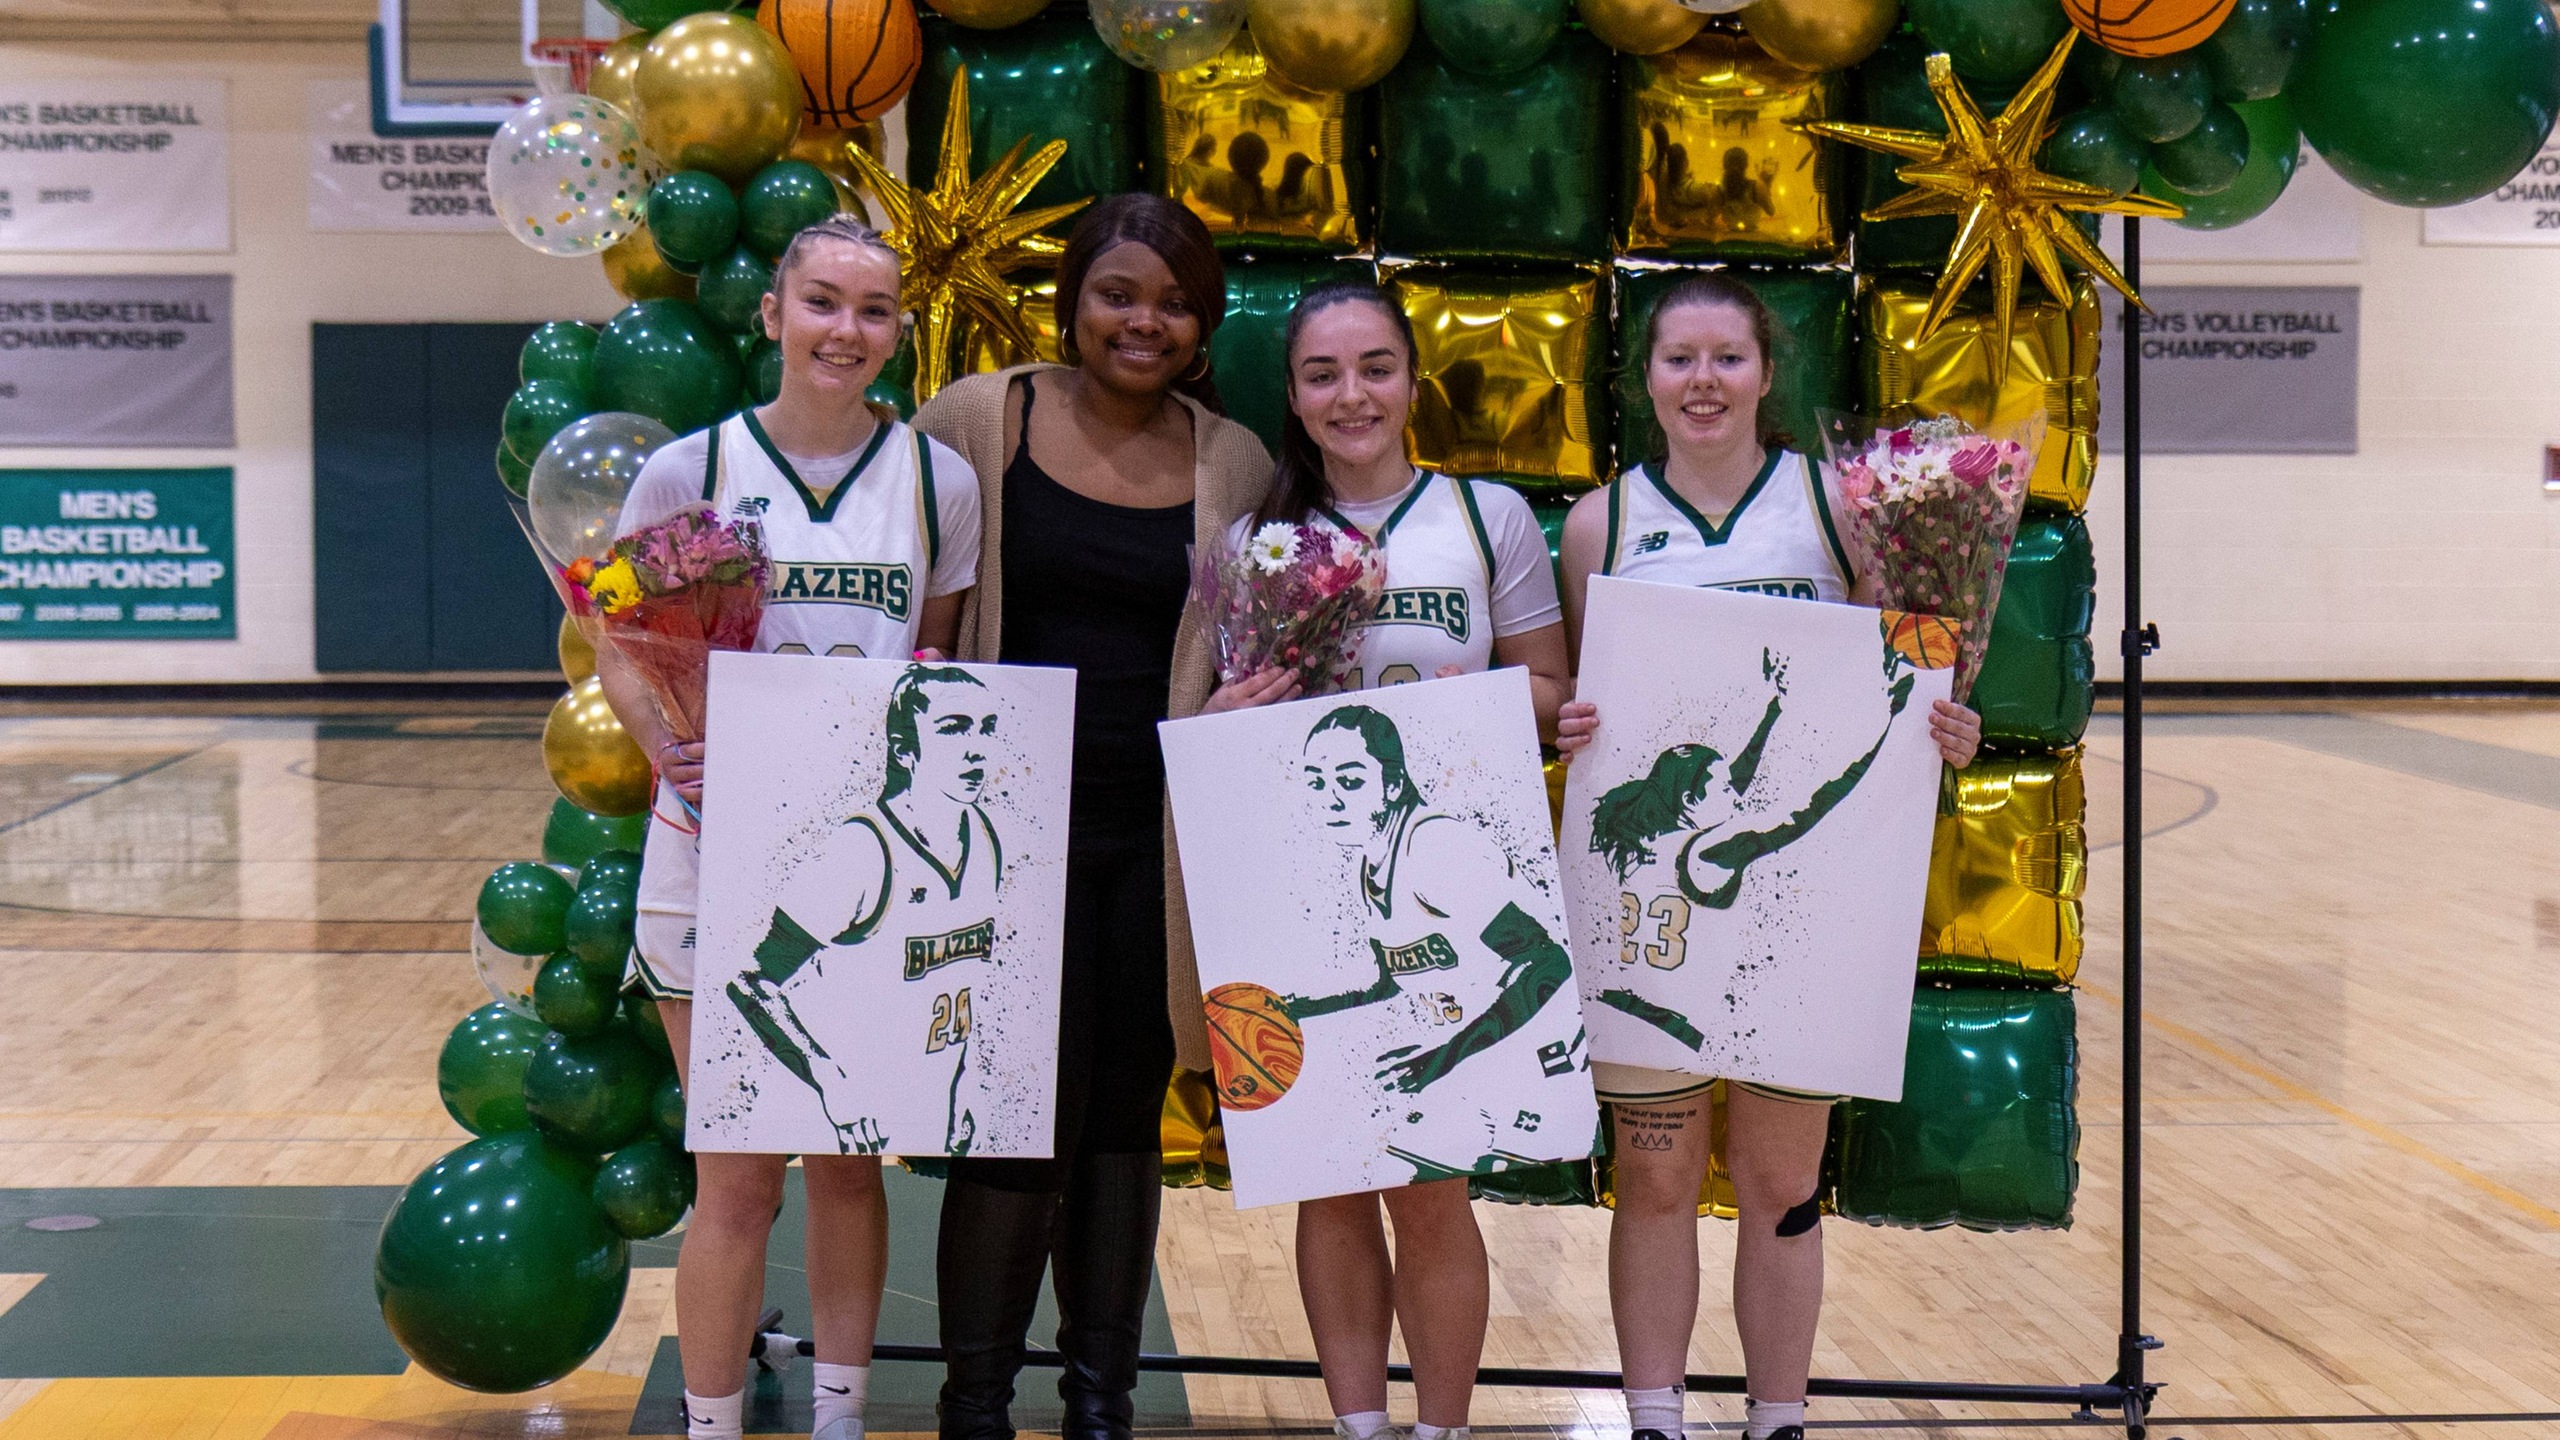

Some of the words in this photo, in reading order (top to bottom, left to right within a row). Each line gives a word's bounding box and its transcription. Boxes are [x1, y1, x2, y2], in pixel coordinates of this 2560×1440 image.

[38, 104, 201, 126] BASKETBALL
[330, 143, 405, 165] MEN'S
[51, 301, 213, 324] BASKETBALL
[2117, 313, 2187, 333] EN'S
[2193, 313, 2342, 333] VOLLEYBALL
[2141, 340, 2317, 360] CHAMPIONSHIP
[59, 489, 158, 519] MEN'S
[1, 525, 210, 554] BASKETBALL
[0, 560, 226, 589] CHAMPIONSHIP
[773, 566, 912, 619] AZERS
[1618, 891, 1691, 971] 23
[907, 921, 995, 978] BLAZERS
